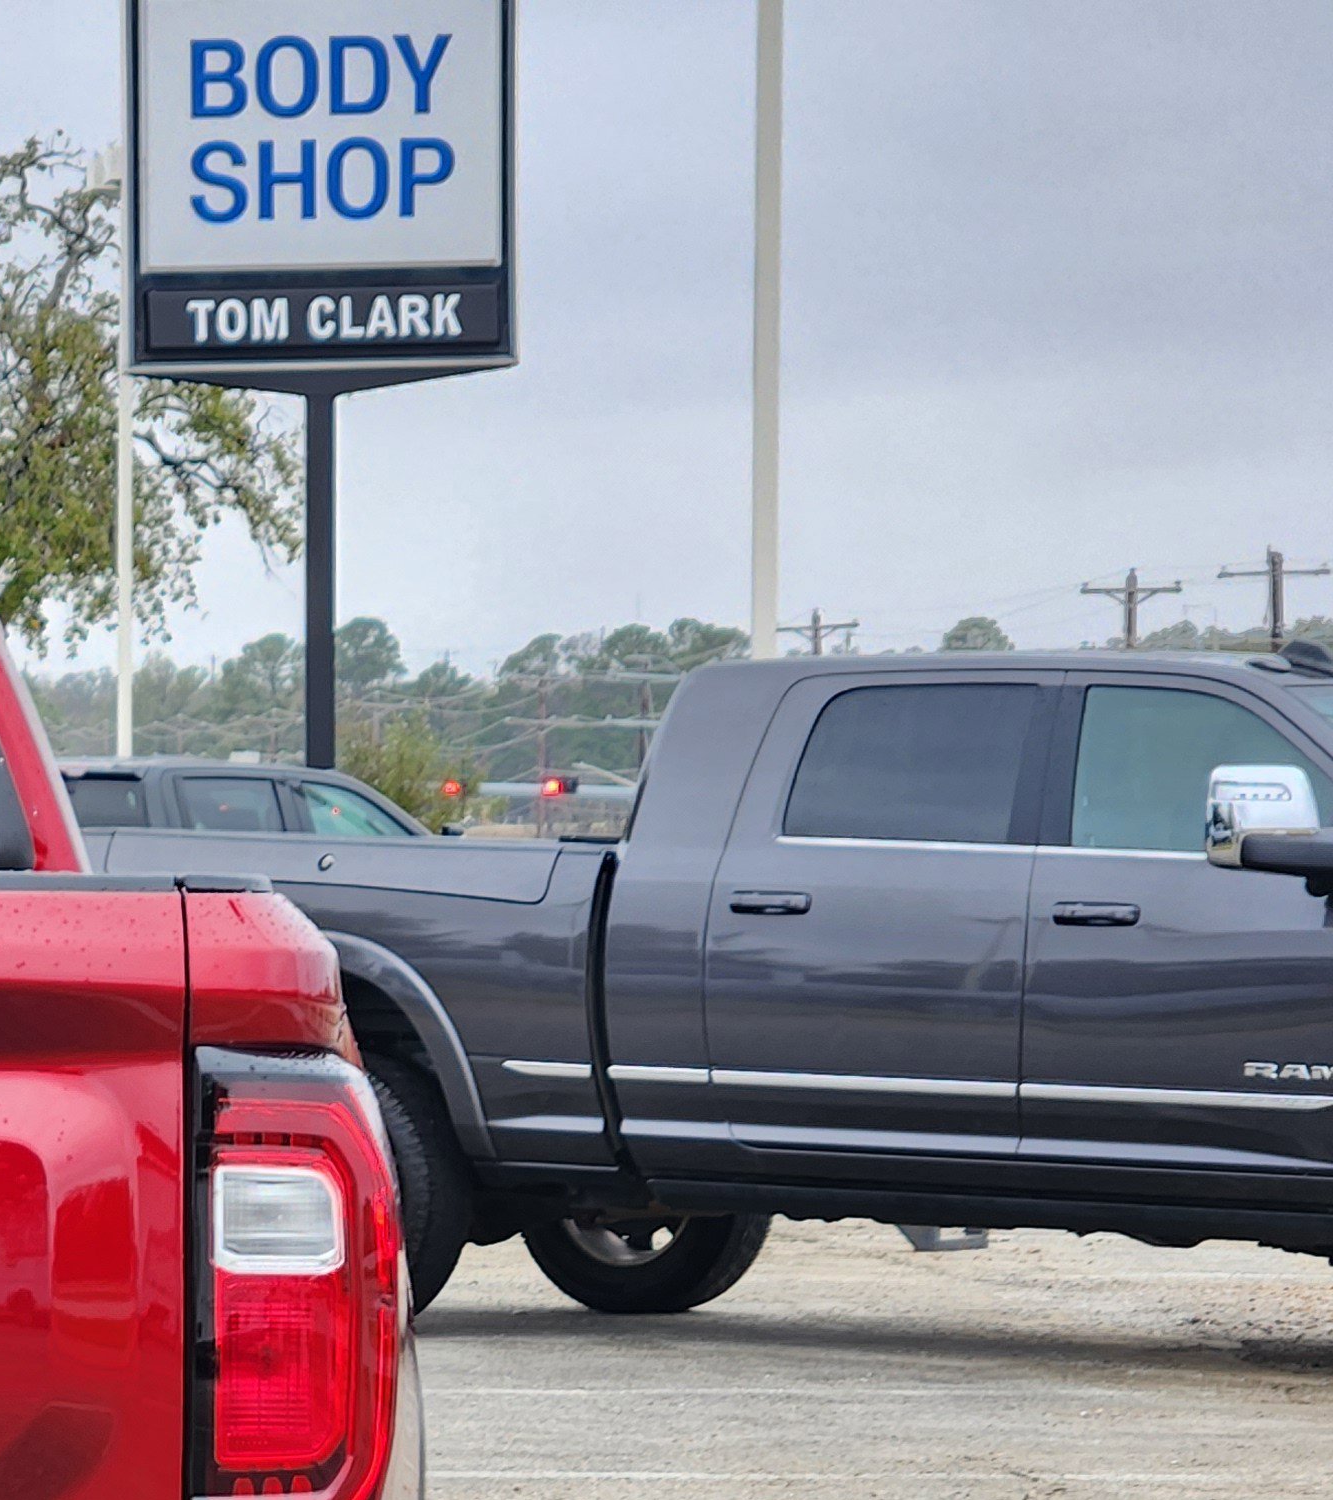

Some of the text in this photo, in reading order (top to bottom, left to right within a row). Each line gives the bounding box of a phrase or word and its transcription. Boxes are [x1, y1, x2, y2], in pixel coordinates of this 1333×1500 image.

[190, 34, 452, 118] BODY
[190, 137, 455, 223] SHOP
[186, 293, 463, 343] TOM CLARK
[1244, 1062, 1333, 1080] RAM
